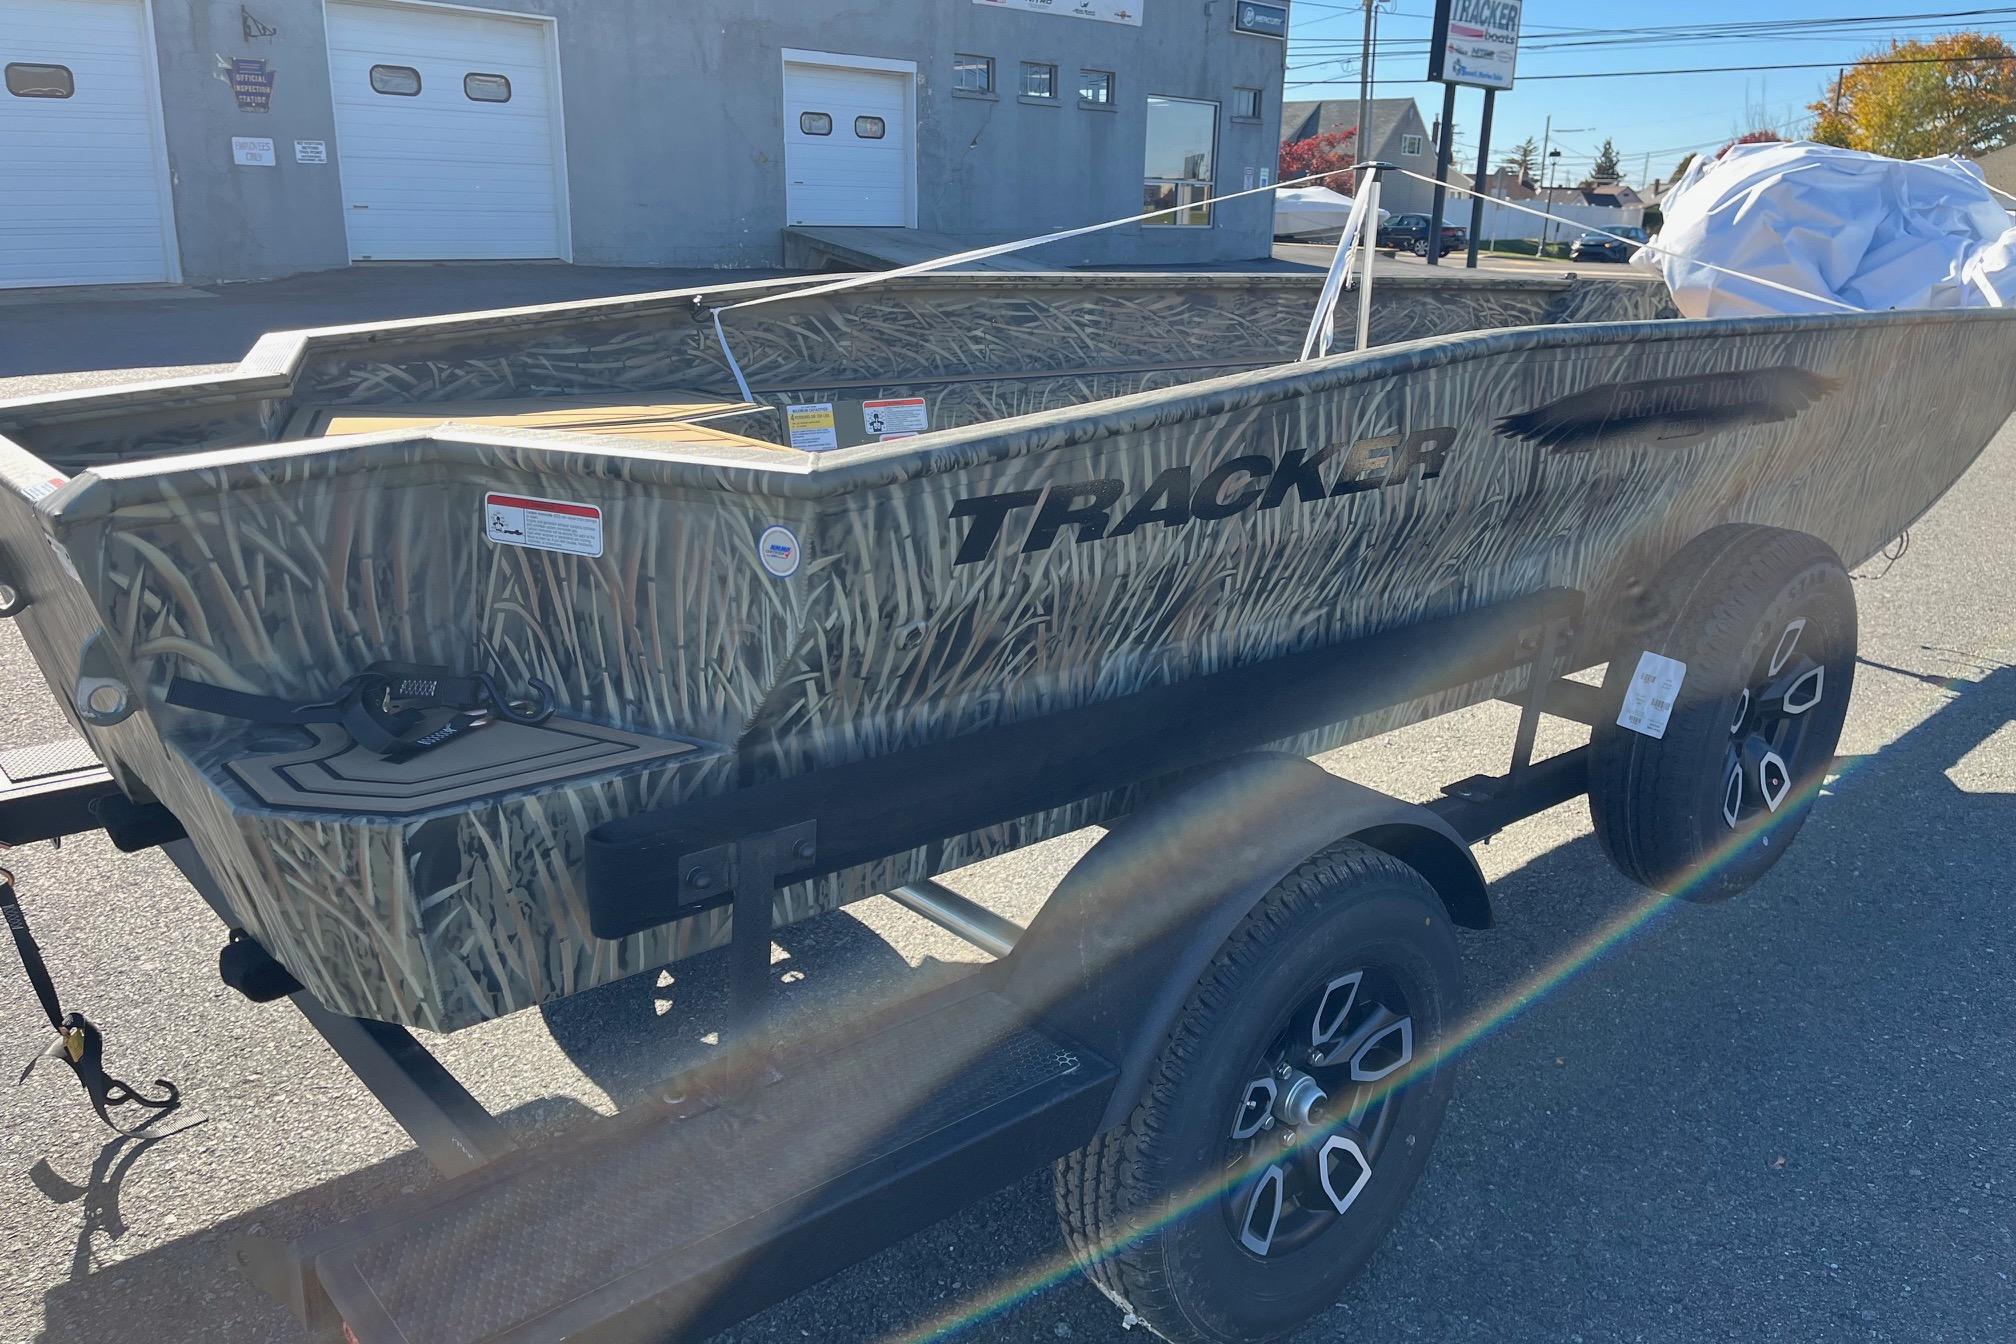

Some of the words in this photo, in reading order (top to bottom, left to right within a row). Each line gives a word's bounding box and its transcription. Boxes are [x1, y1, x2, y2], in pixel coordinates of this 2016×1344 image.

[1452, 0, 1518, 31] TRACKER
[1485, 28, 1514, 45] boats
[236, 74, 267, 83] OFFICIAL
[234, 84, 271, 94] INSPECTION
[948, 427, 1458, 566] TRACKER
